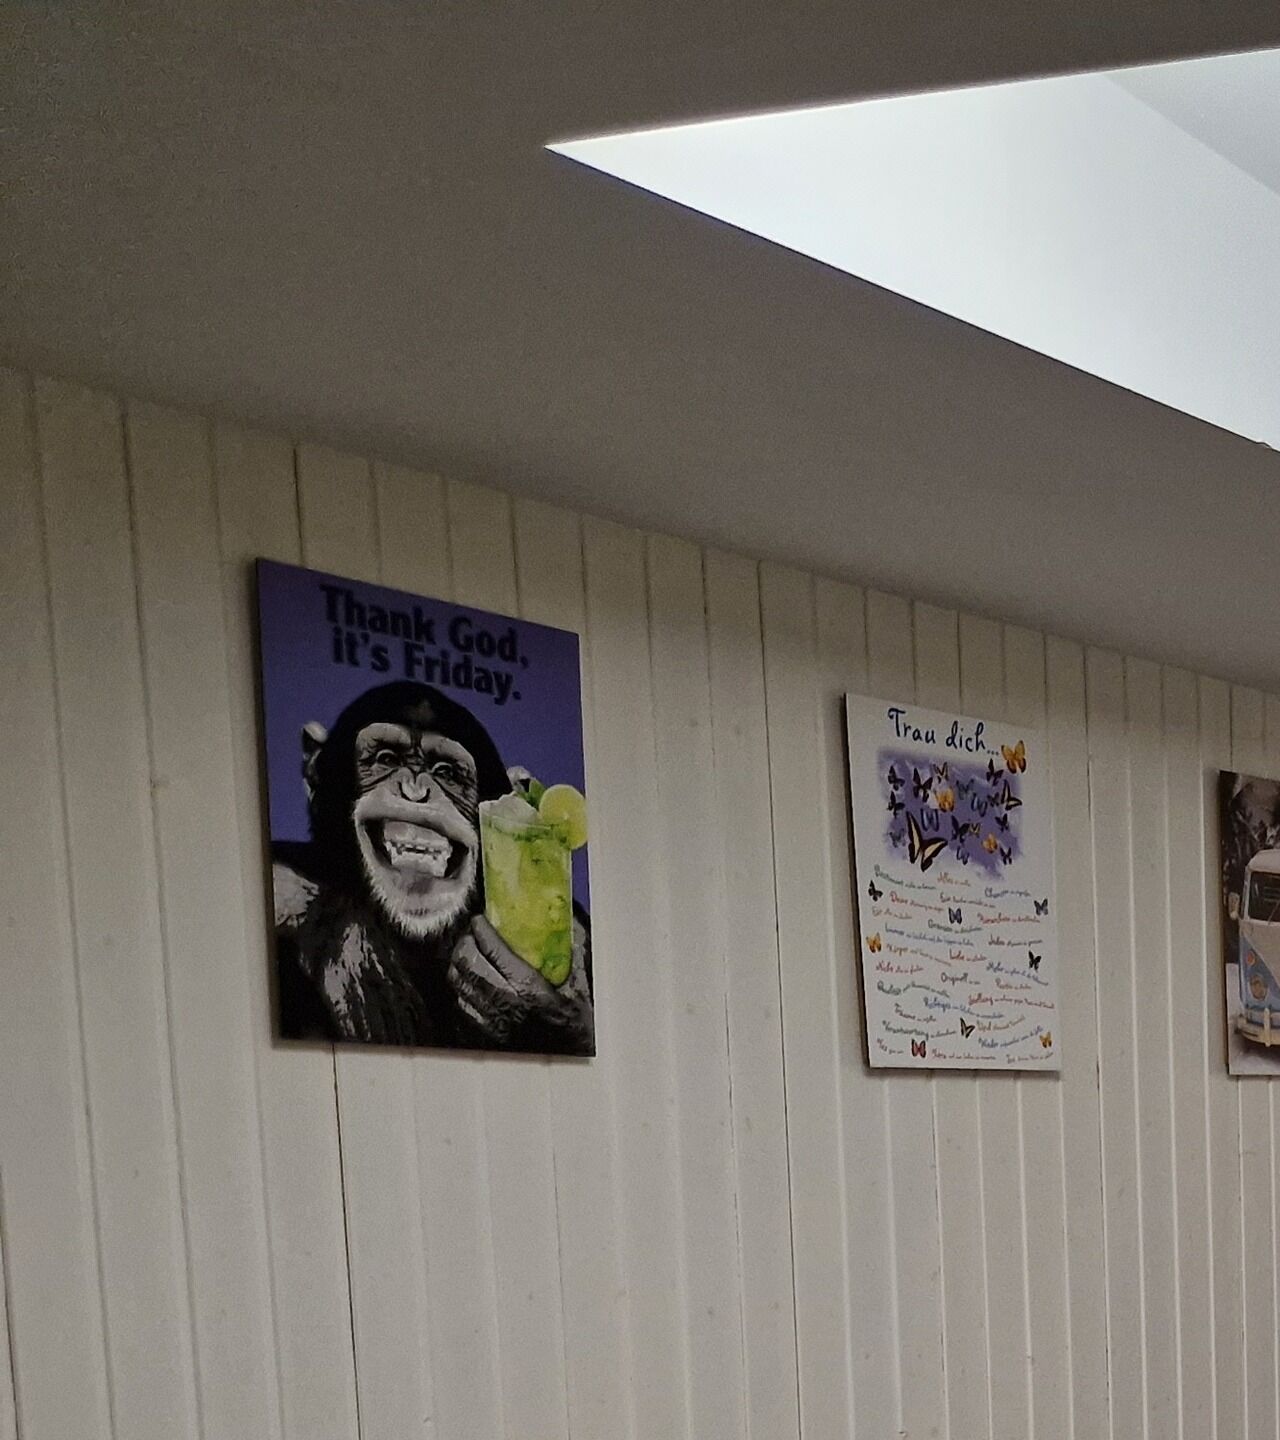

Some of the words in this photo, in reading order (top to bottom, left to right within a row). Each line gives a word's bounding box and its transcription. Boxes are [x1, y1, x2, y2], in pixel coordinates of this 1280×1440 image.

[319, 584, 436, 645] Thank
[446, 615, 529, 669] God,
[331, 625, 390, 672] it's
[403, 639, 521, 706] Friday.
[887, 706, 937, 745] Trau
